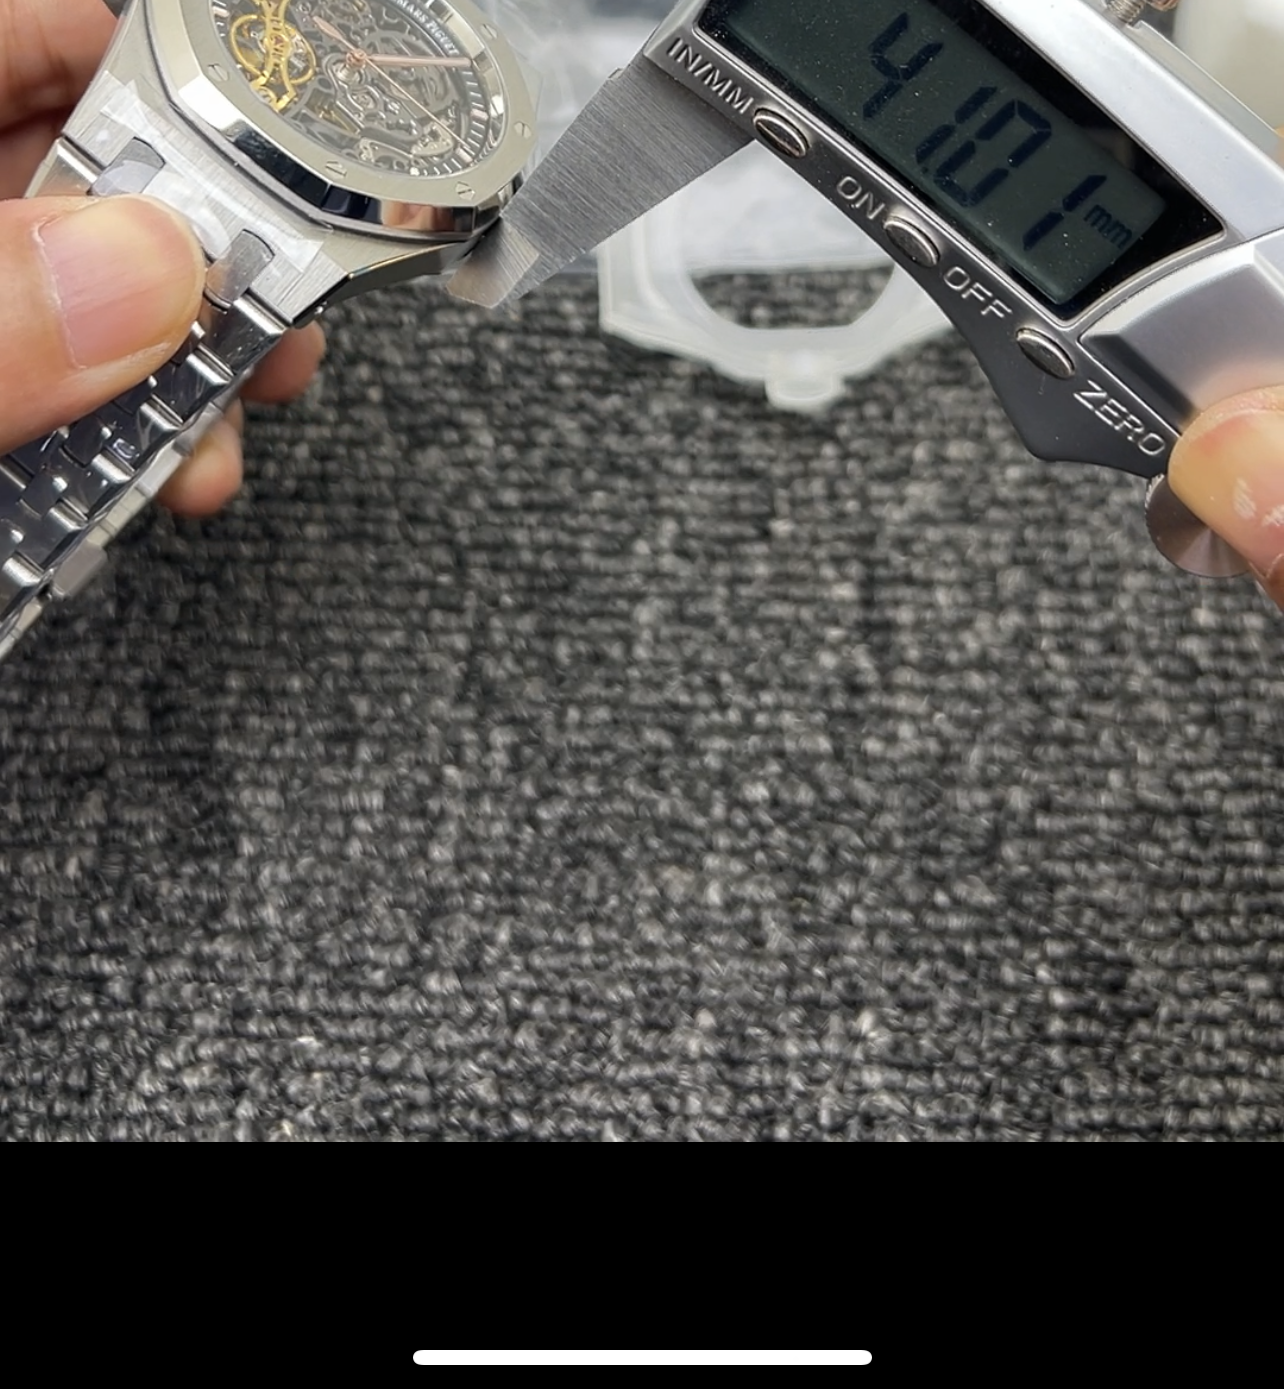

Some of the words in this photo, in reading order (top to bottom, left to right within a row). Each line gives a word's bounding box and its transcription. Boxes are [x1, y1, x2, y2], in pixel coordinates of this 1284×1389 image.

[666, 36, 755, 115] IN/MM
[835, 175, 886, 221] ON
[1084, 203, 1135, 252] mm
[942, 265, 1013, 321] OFF
[1073, 378, 1166, 457] ZERO
